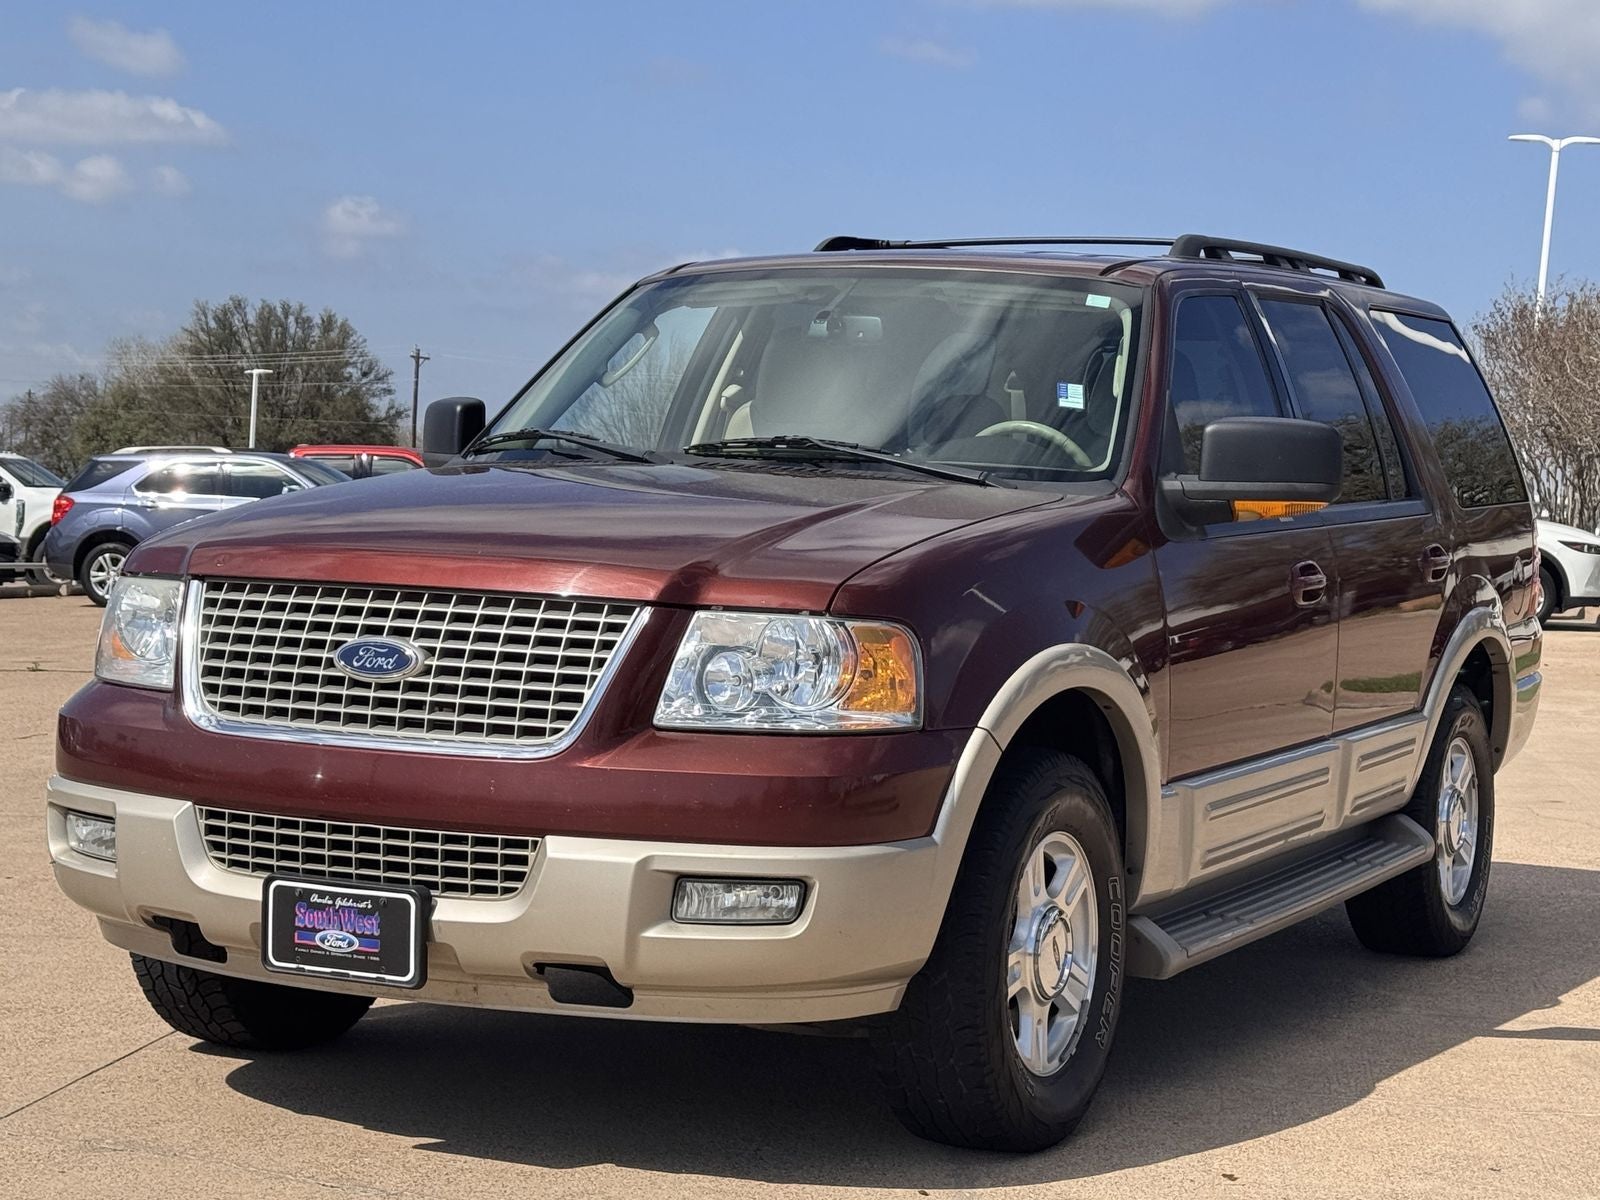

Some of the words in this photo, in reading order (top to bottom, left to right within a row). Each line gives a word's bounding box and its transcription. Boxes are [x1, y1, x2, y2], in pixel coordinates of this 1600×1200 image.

[353, 646, 398, 669] Ford
[324, 934, 349, 948] Ford
[1095, 877, 1122, 1049] COOPER
